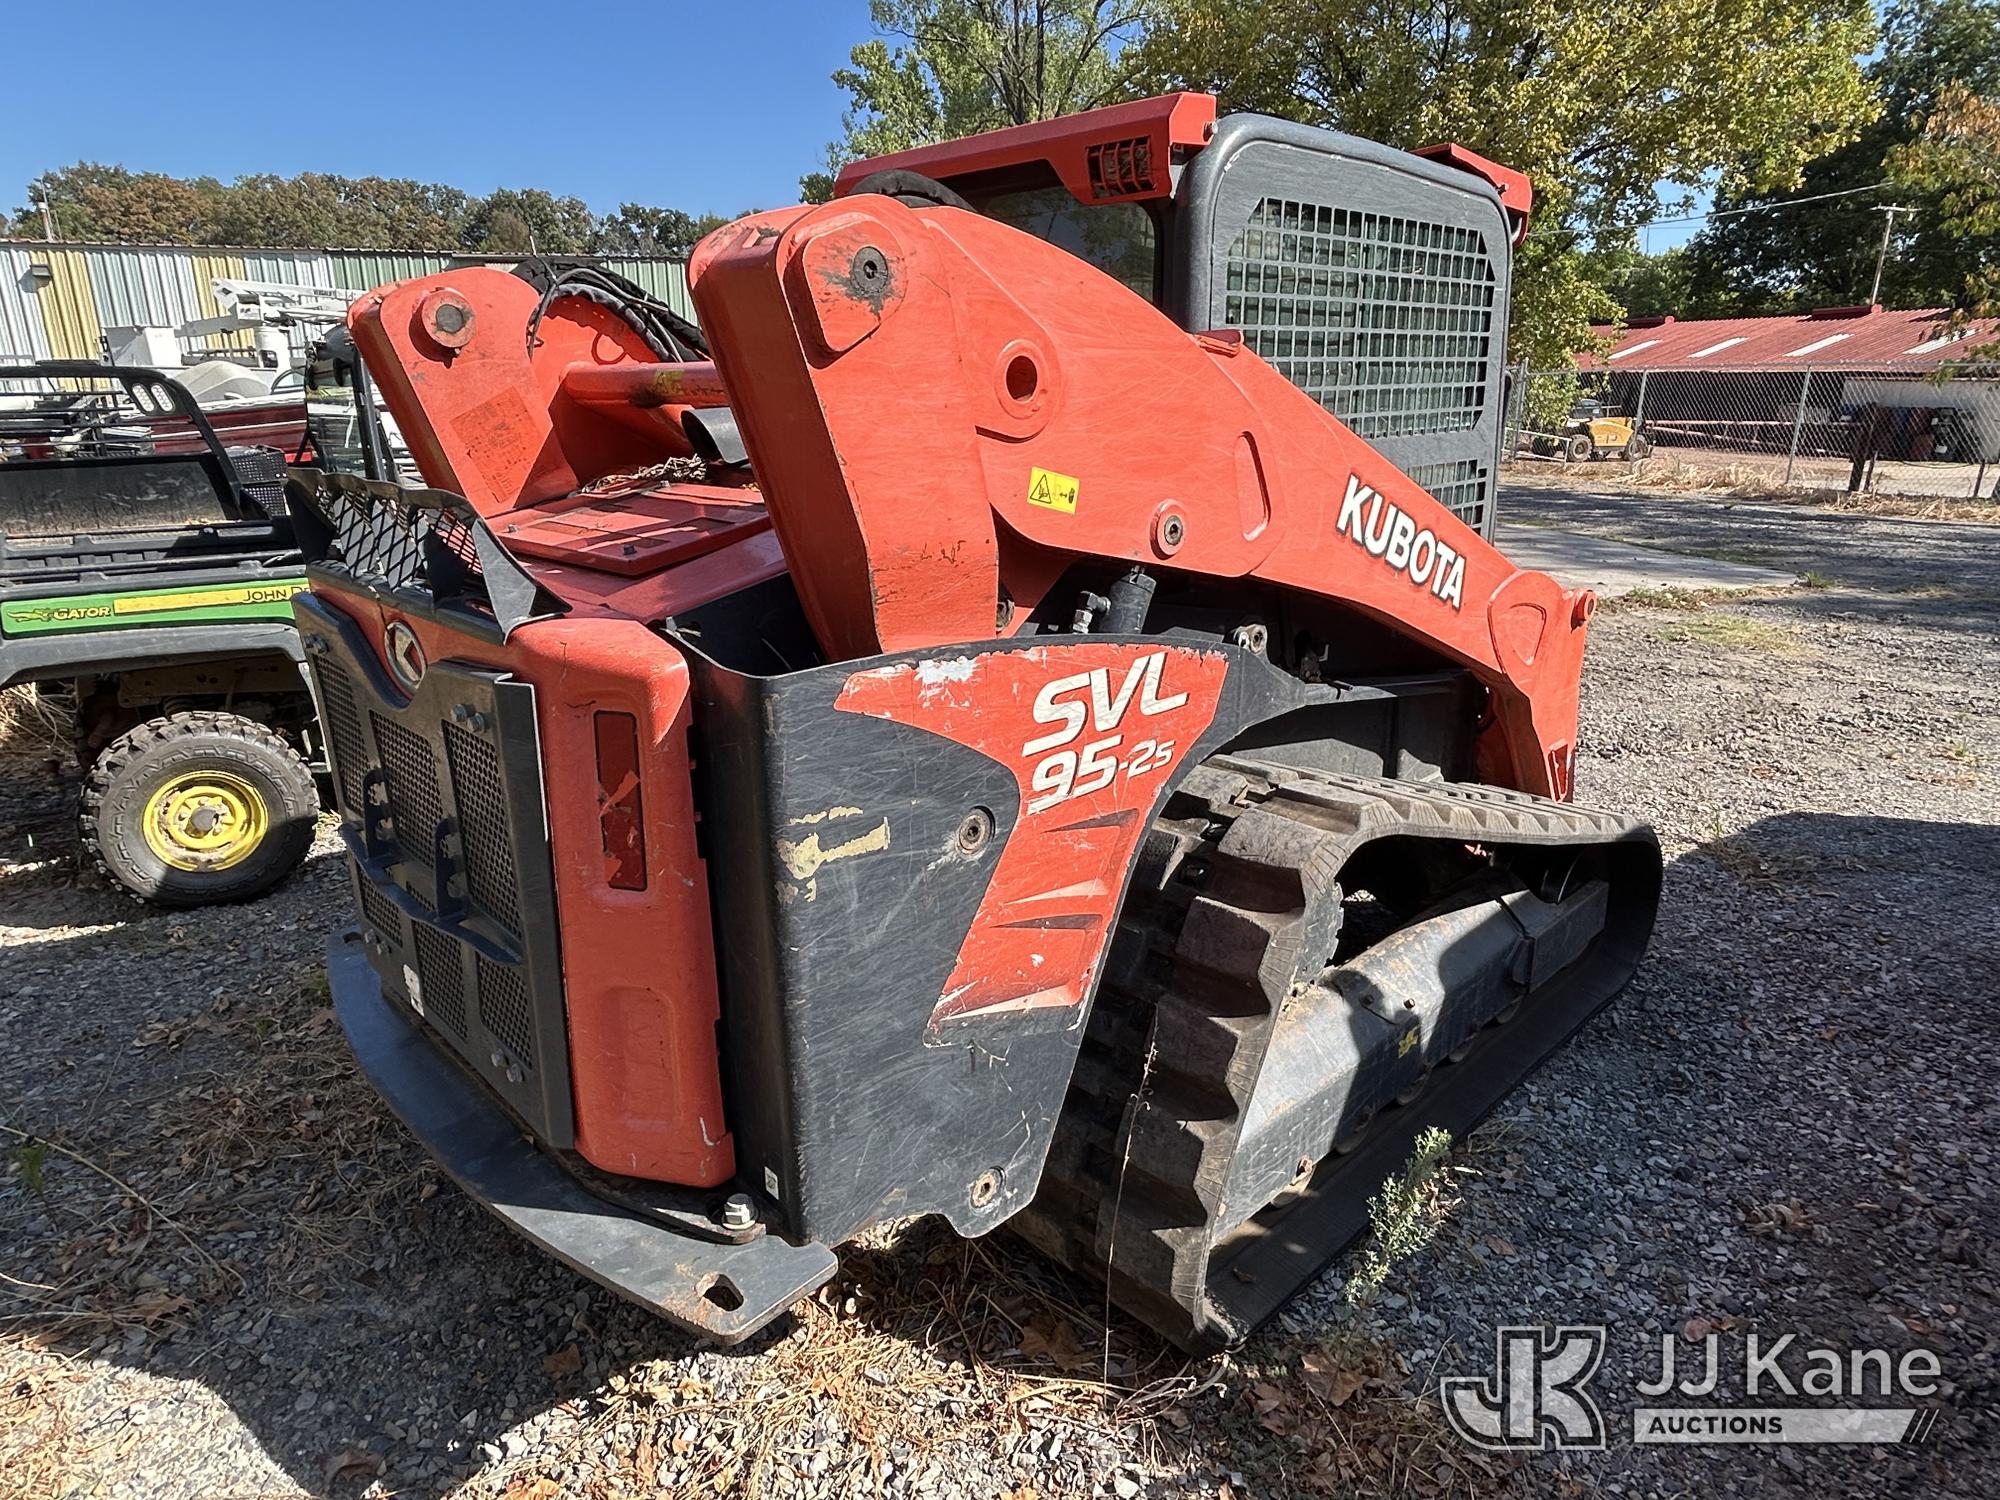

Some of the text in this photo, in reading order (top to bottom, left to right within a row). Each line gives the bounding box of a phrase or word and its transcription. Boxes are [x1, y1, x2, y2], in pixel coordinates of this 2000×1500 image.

[1336, 472, 1467, 612] KUBOTA
[53, 606, 111, 620] GATOR
[242, 586, 288, 603] JOHN
[1022, 651, 1190, 758] SVL
